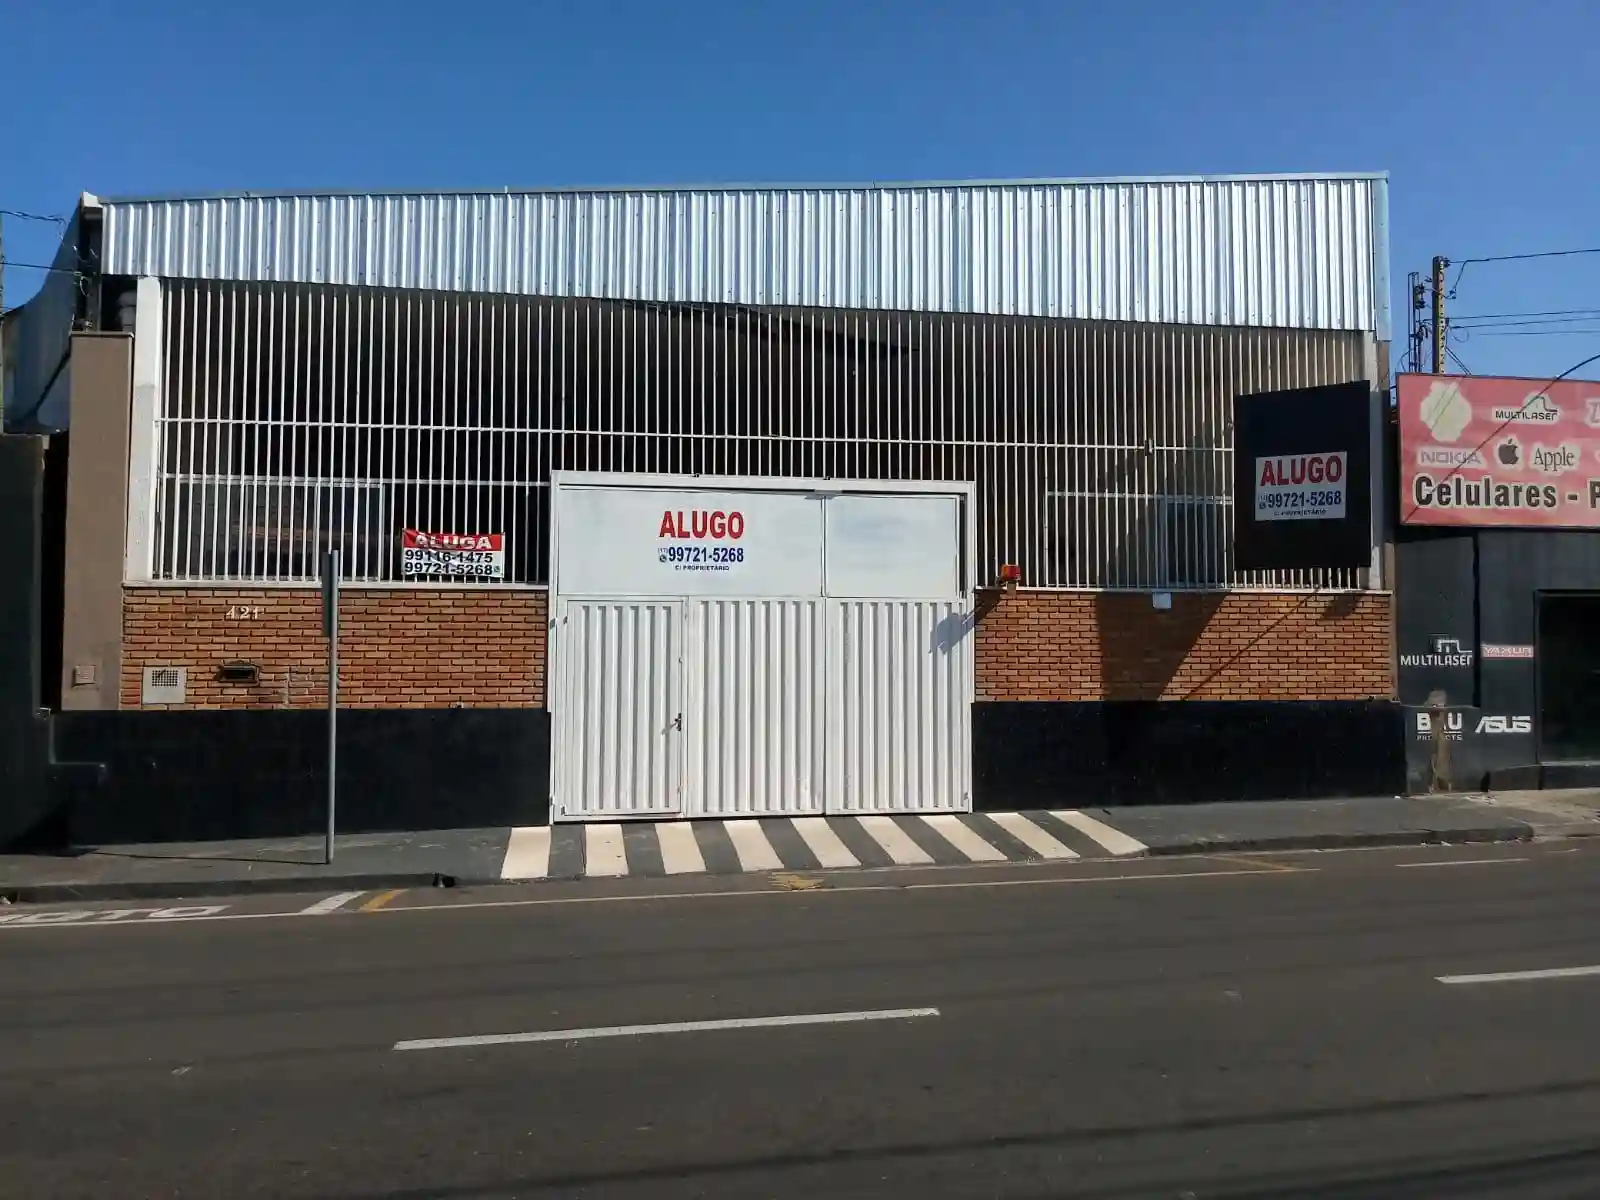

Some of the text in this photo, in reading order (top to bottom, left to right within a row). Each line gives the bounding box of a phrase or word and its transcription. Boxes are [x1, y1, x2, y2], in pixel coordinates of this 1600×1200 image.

[1420, 450, 1482, 464] NOKIA
[1534, 445, 1576, 471] Apple
[1260, 455, 1342, 486] ALUGO
[1268, 490, 1342, 509] 99721-5268
[1415, 476, 1557, 508] Celulares
[659, 510, 744, 539] ALUGO
[415, 532, 492, 549] ALUGA
[405, 549, 493, 564] 99116-1475
[668, 546, 744, 563] 99721-5268
[404, 562, 493, 576] 99721-5268
[1417, 712, 1462, 731] BU
[1475, 715, 1532, 734] ASUS
